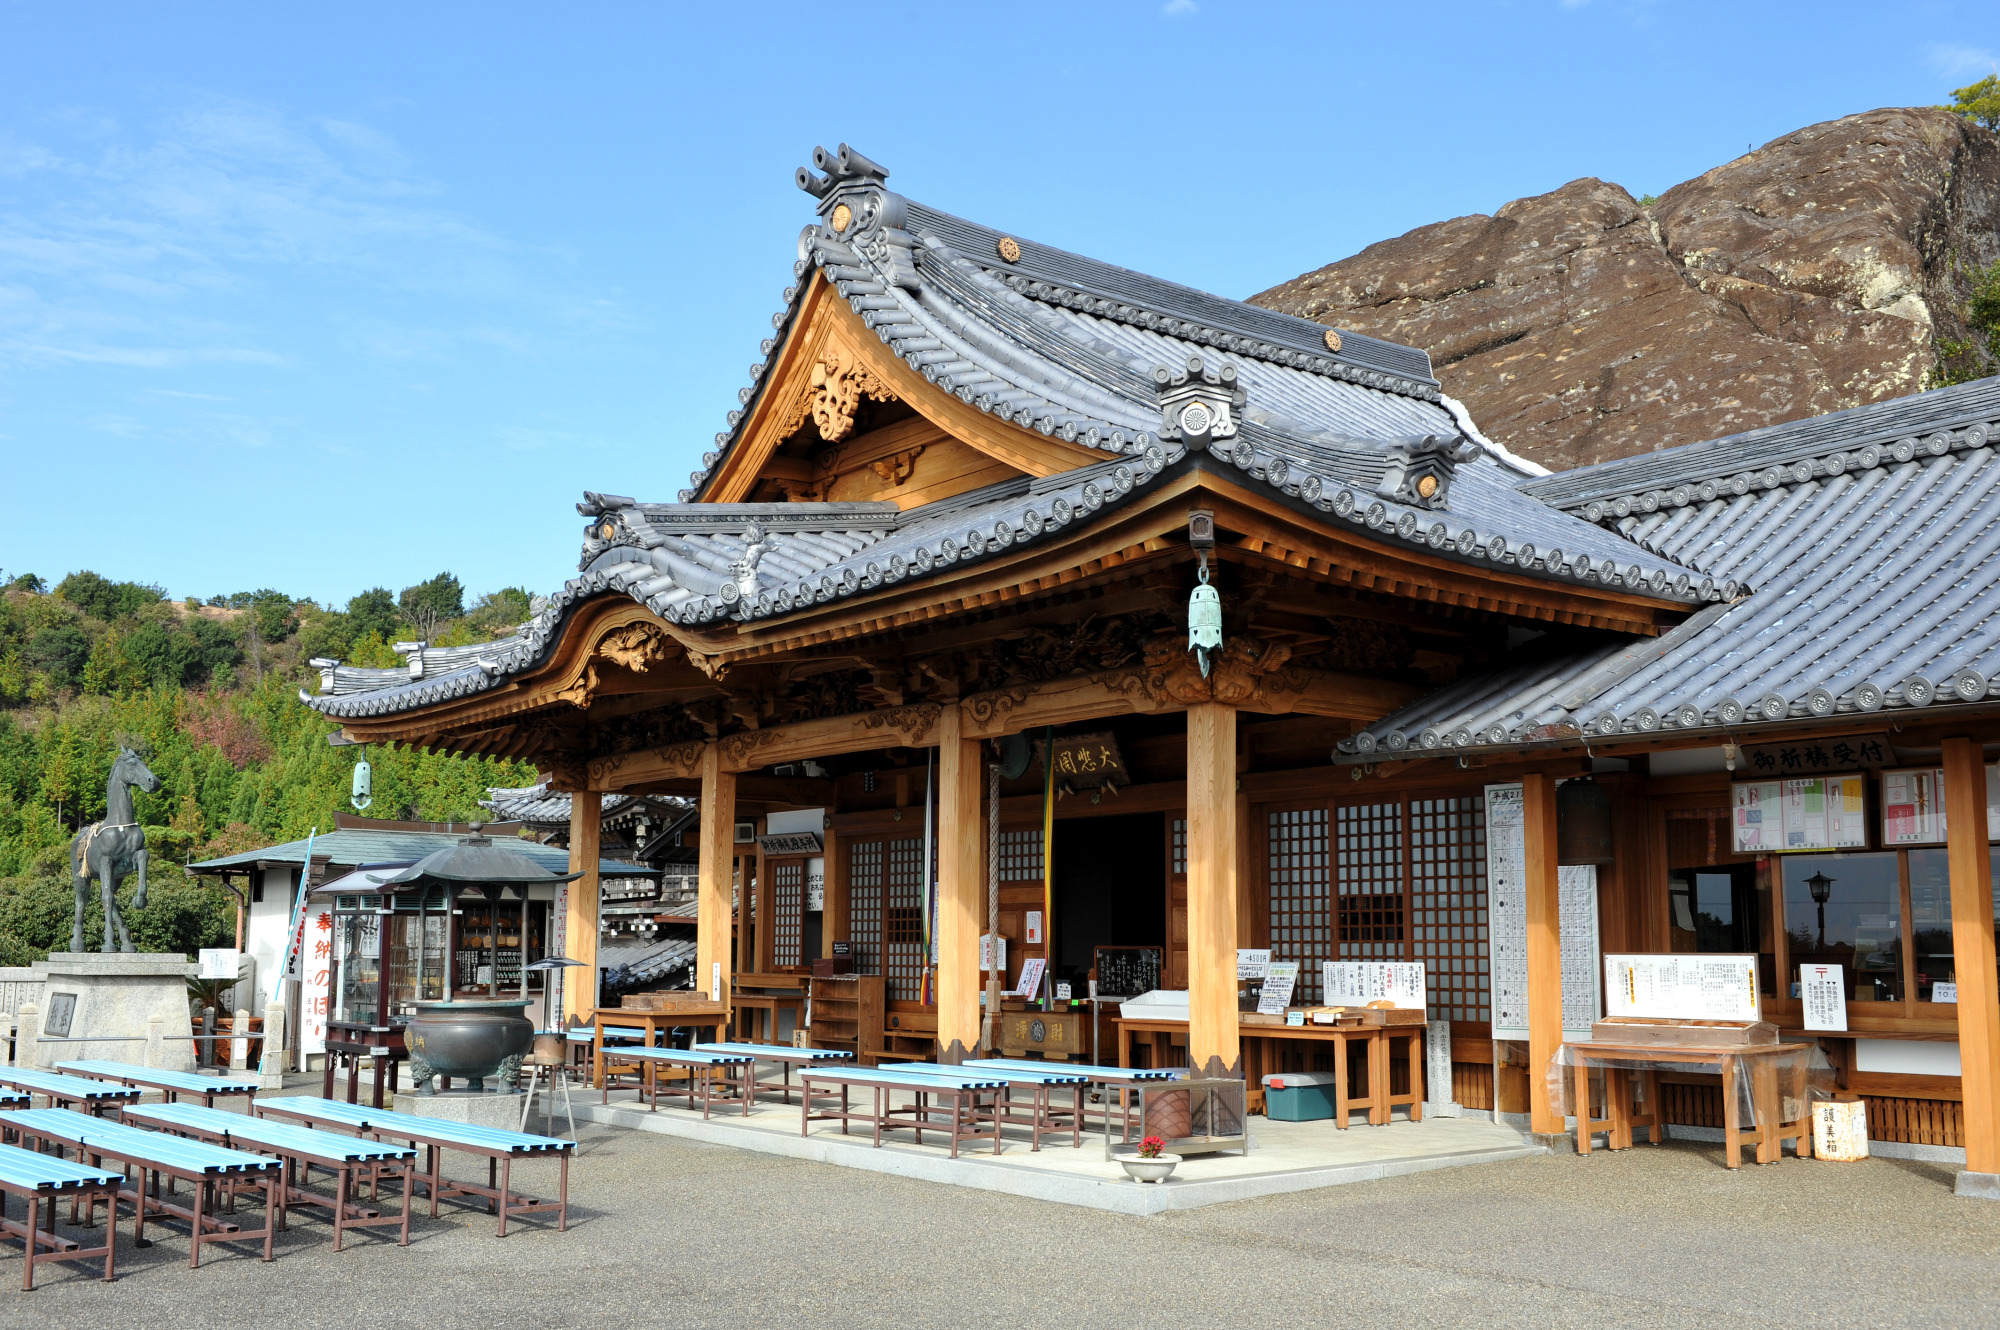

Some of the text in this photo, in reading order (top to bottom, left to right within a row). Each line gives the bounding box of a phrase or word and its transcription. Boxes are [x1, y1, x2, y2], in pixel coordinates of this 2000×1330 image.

[1789, 778, 1813, 787] 交通安全
[1493, 790, 1524, 801] 平成21
[1823, 1107, 1837, 1153] 護美箱
